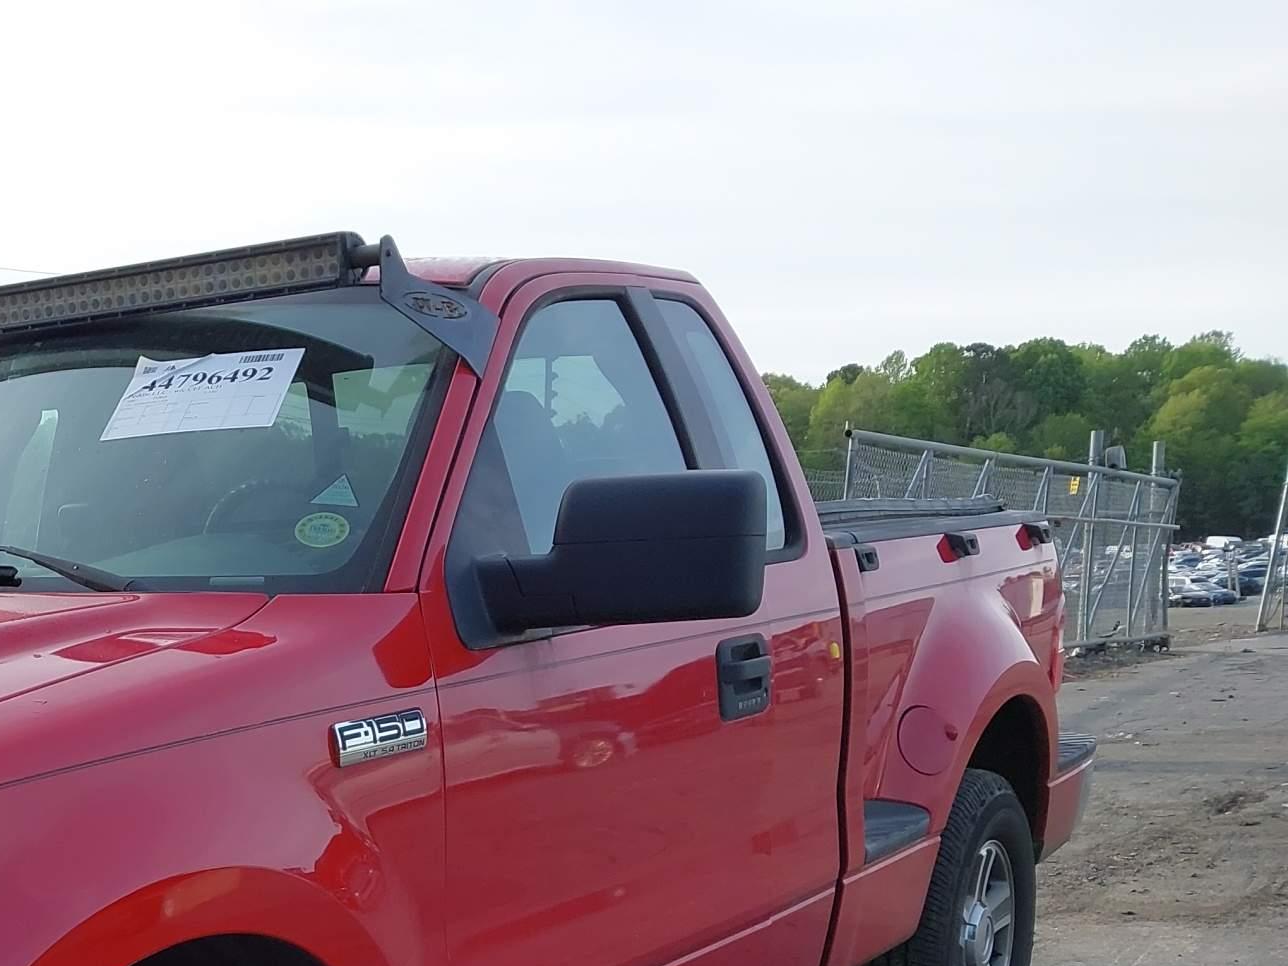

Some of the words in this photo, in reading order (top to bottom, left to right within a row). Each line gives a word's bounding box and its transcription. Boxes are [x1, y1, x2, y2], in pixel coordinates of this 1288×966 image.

[142, 366, 274, 393] 44796492
[362, 750, 378, 759] XLT
[396, 738, 425, 751] TRITON
